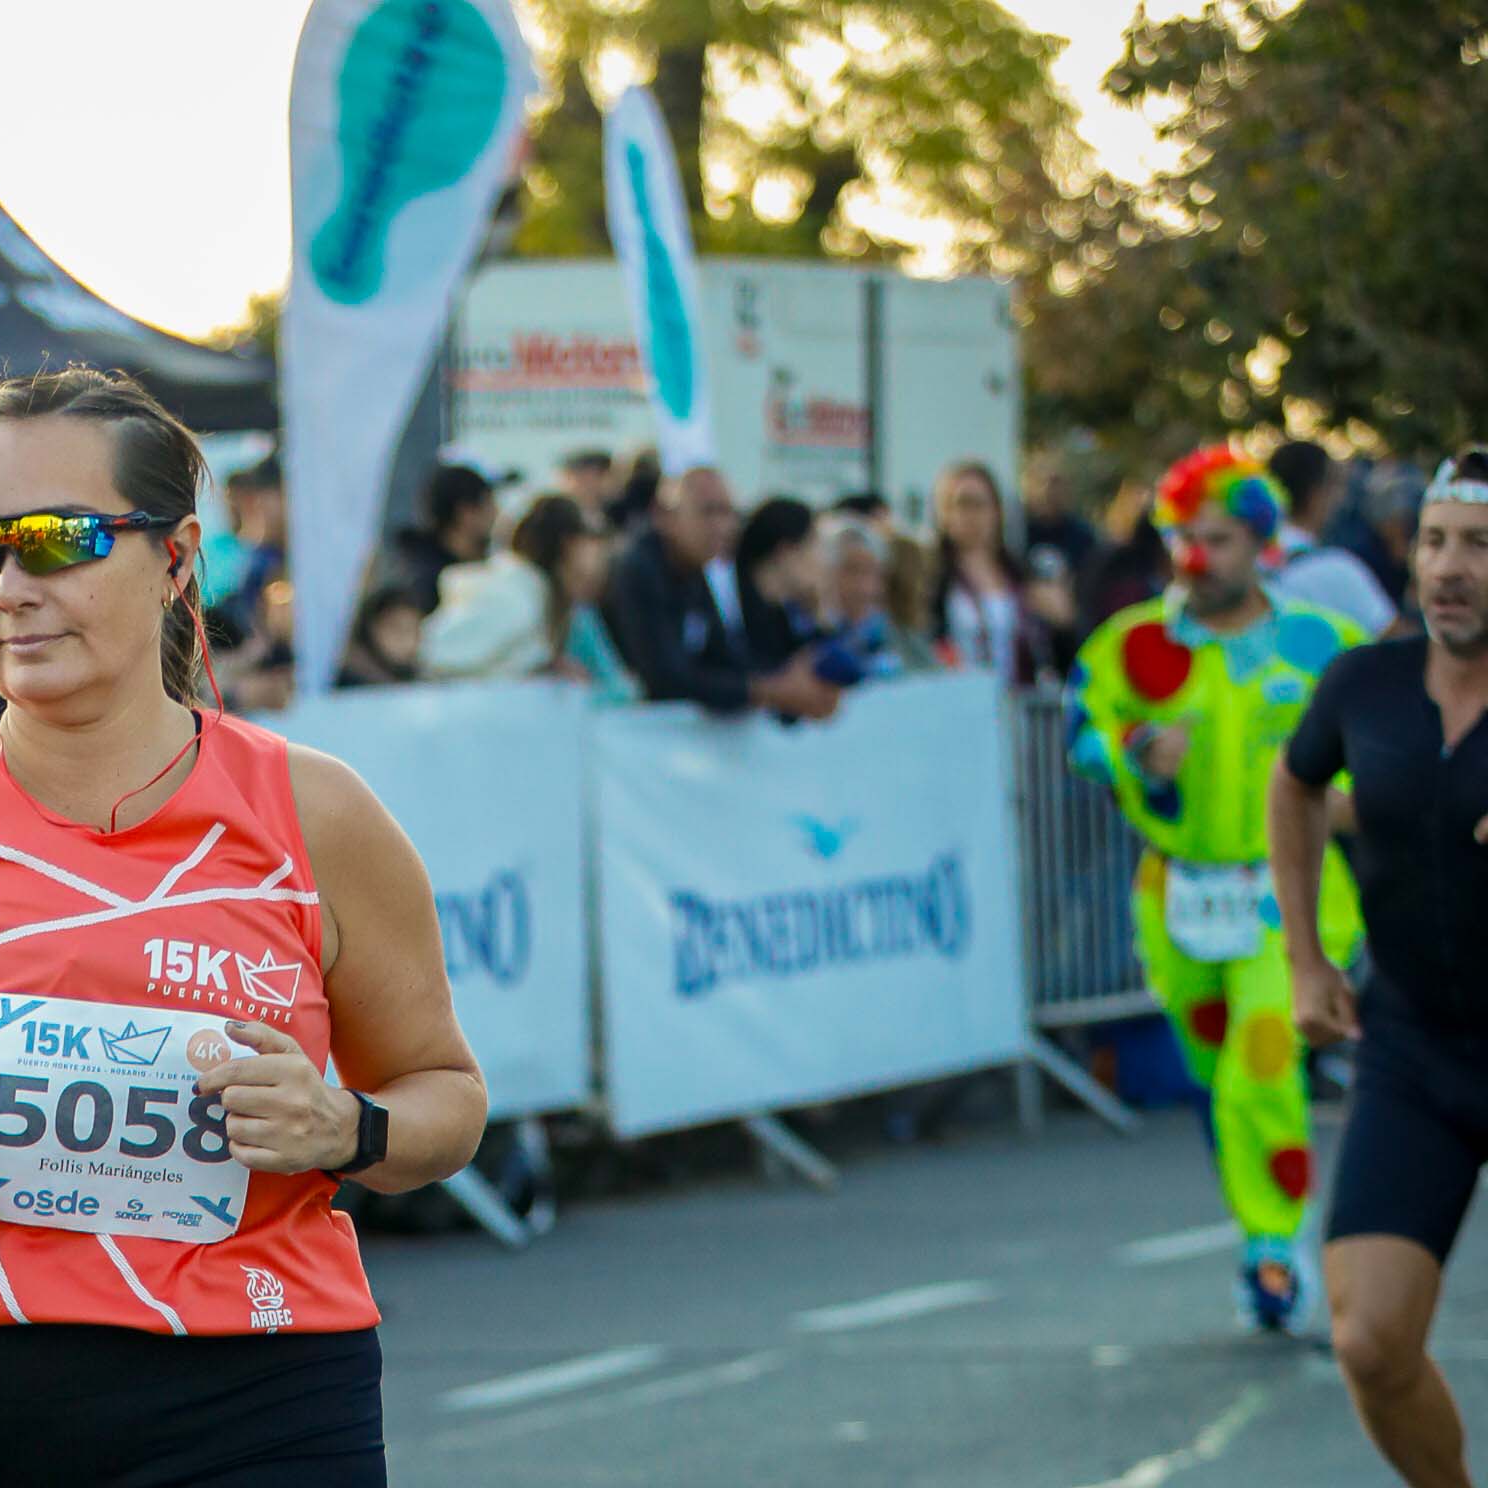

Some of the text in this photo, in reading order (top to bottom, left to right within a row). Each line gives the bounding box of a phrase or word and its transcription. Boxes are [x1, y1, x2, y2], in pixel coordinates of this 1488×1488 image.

[143, 938, 232, 992] 15K
[146, 982, 293, 1024] PUERTO NORTE
[20, 1019, 93, 1060] 15K
[194, 1041, 223, 1062] 4K
[38, 1157, 184, 1184] Follis Mariángeles
[13, 1189, 100, 1216] osde
[250, 1308, 293, 1329] ARDEC
